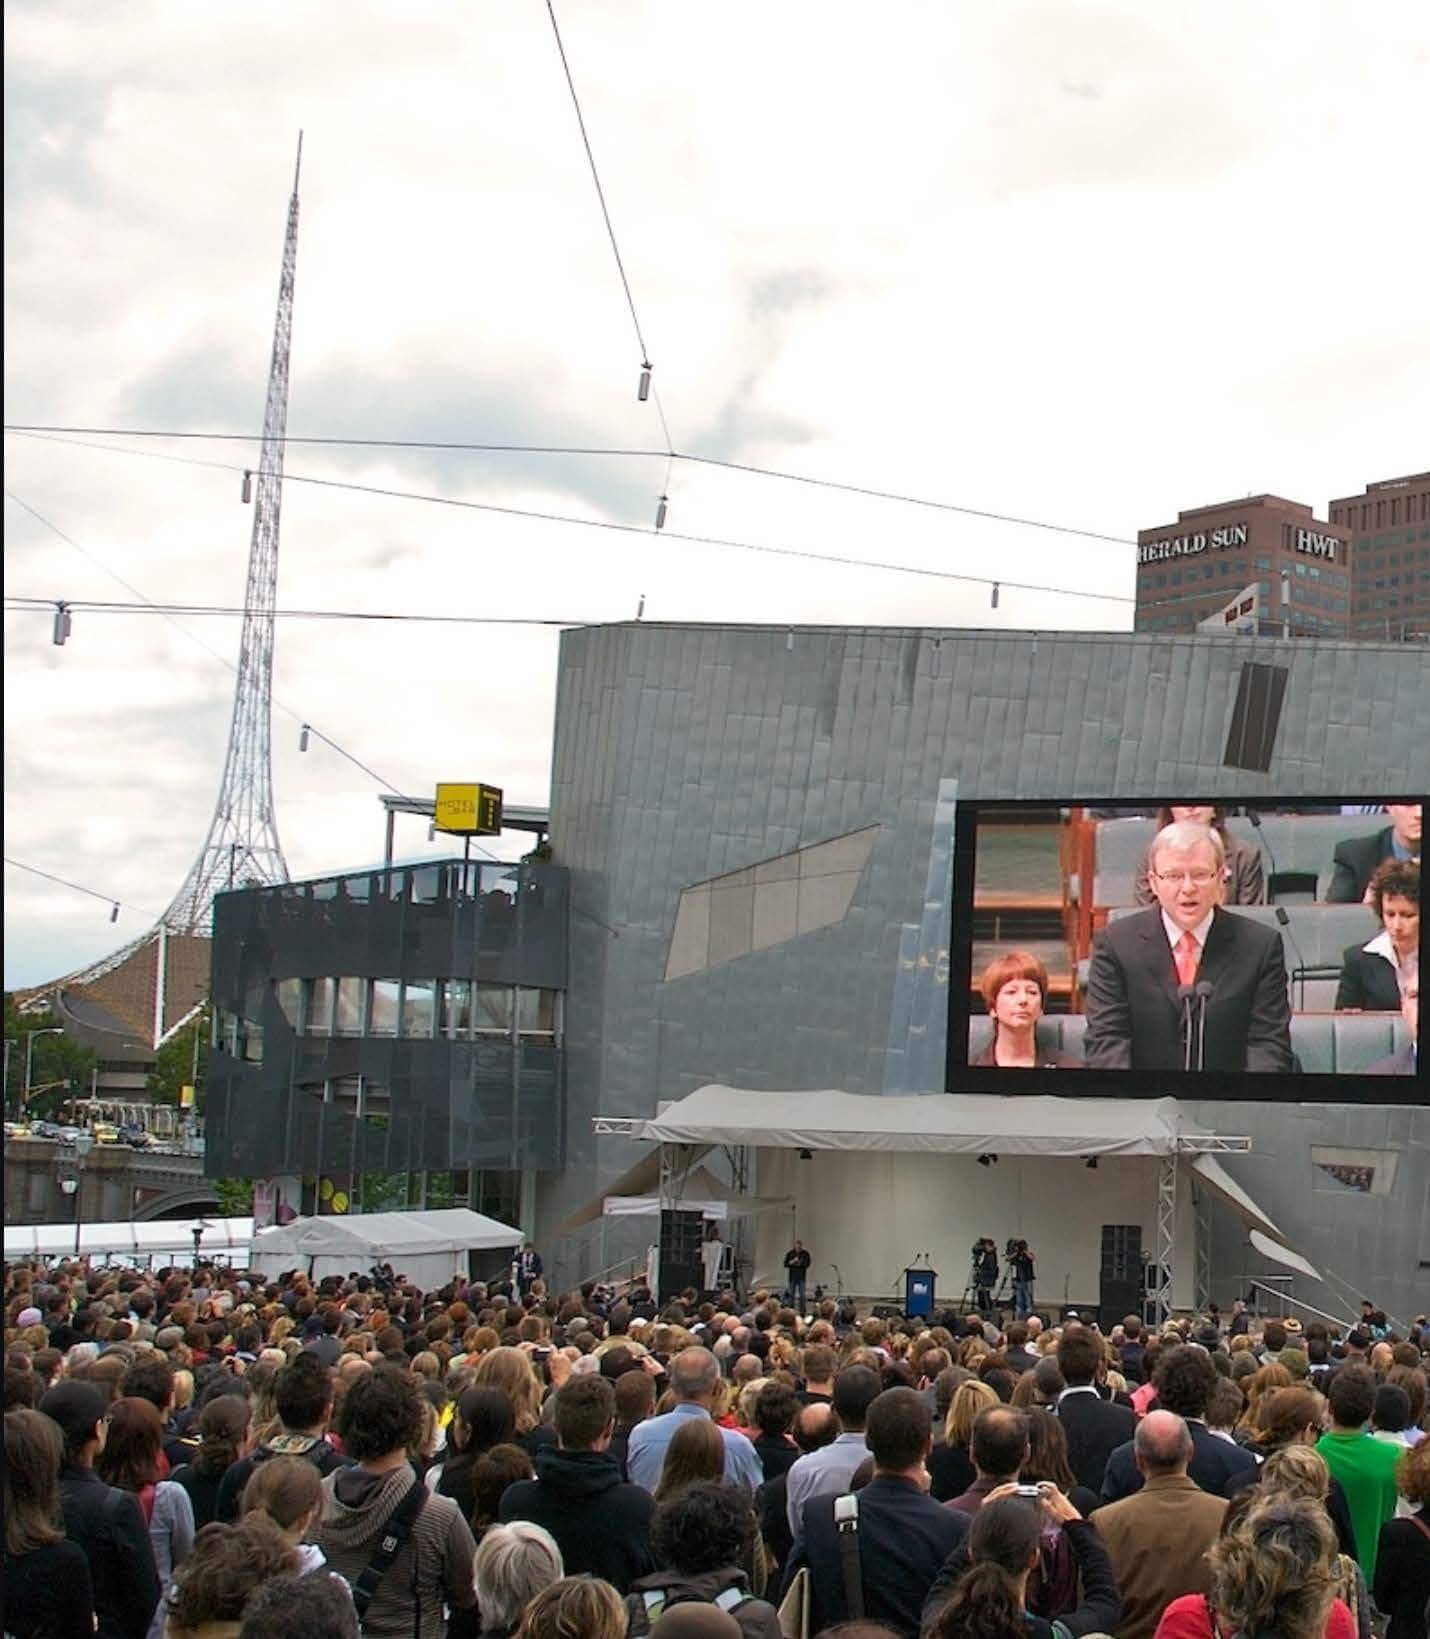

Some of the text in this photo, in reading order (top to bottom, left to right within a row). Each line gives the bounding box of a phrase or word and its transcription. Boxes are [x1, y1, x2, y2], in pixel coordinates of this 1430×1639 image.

[1137, 525, 1248, 564] HERALD SUN
[1297, 529, 1340, 560] HWT
